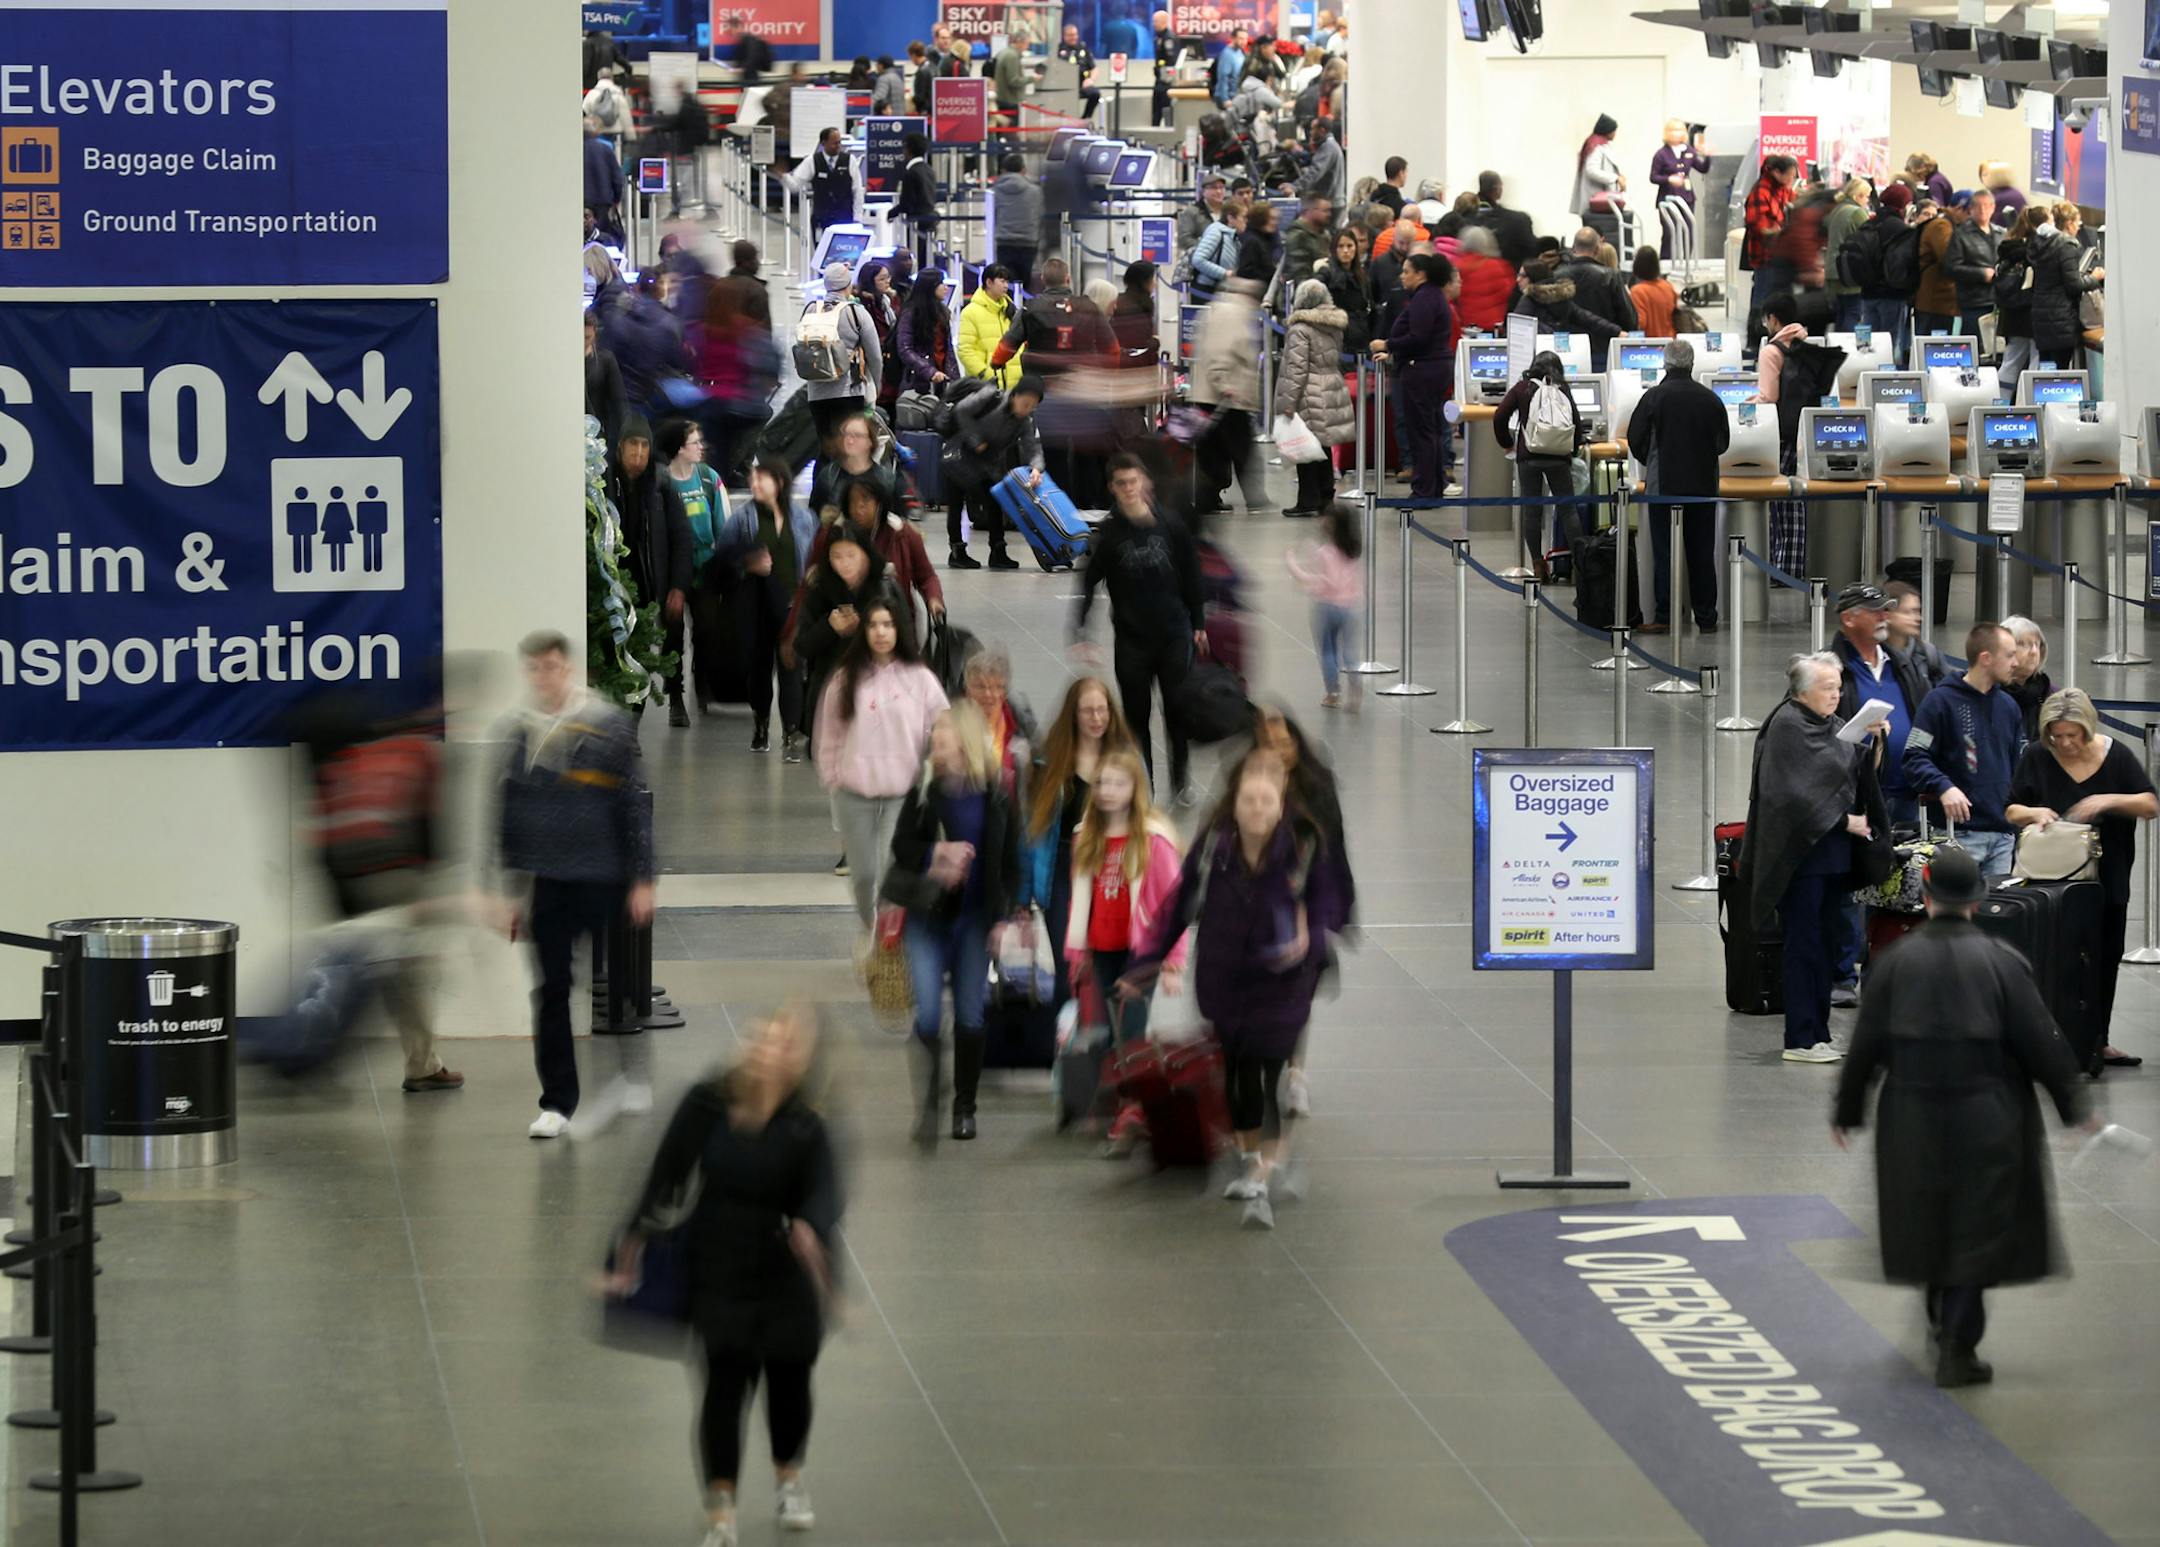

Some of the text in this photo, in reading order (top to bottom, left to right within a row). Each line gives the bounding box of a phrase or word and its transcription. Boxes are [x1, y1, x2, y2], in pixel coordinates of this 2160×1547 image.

[719, 8, 756, 21] SKY
[948, 7, 986, 20] SKY
[719, 22, 806, 35] PIORITY
[1, 65, 276, 115] Elevators
[937, 106, 977, 116] BAGGAGE
[1763, 135, 1808, 145] OVERSIZE
[1763, 146, 1808, 156] BAGGAGE
[84, 147, 276, 176] Baggage Claim
[84, 210, 377, 238] Ground Transportation
[1629, 353, 1650, 361] CHECK
[1933, 352, 1963, 360] CHECK IN
[1721, 388, 1753, 397] CHECK IN
[2042, 387, 2065, 395] CHECK
[69, 364, 227, 488] TO
[1823, 424, 1857, 433] CHECK IN
[0, 532, 229, 595] aim &
[1509, 774, 1614, 792] Oversized
[1515, 794, 1609, 815] Baggage
[1514, 860, 1619, 868] DELTA FRONTIER
[1504, 929, 1620, 942] spirit After hours
[118, 1017, 224, 1033] trash to energy
[1563, 1252, 1946, 1520] OVERSIZED BAG DROP
